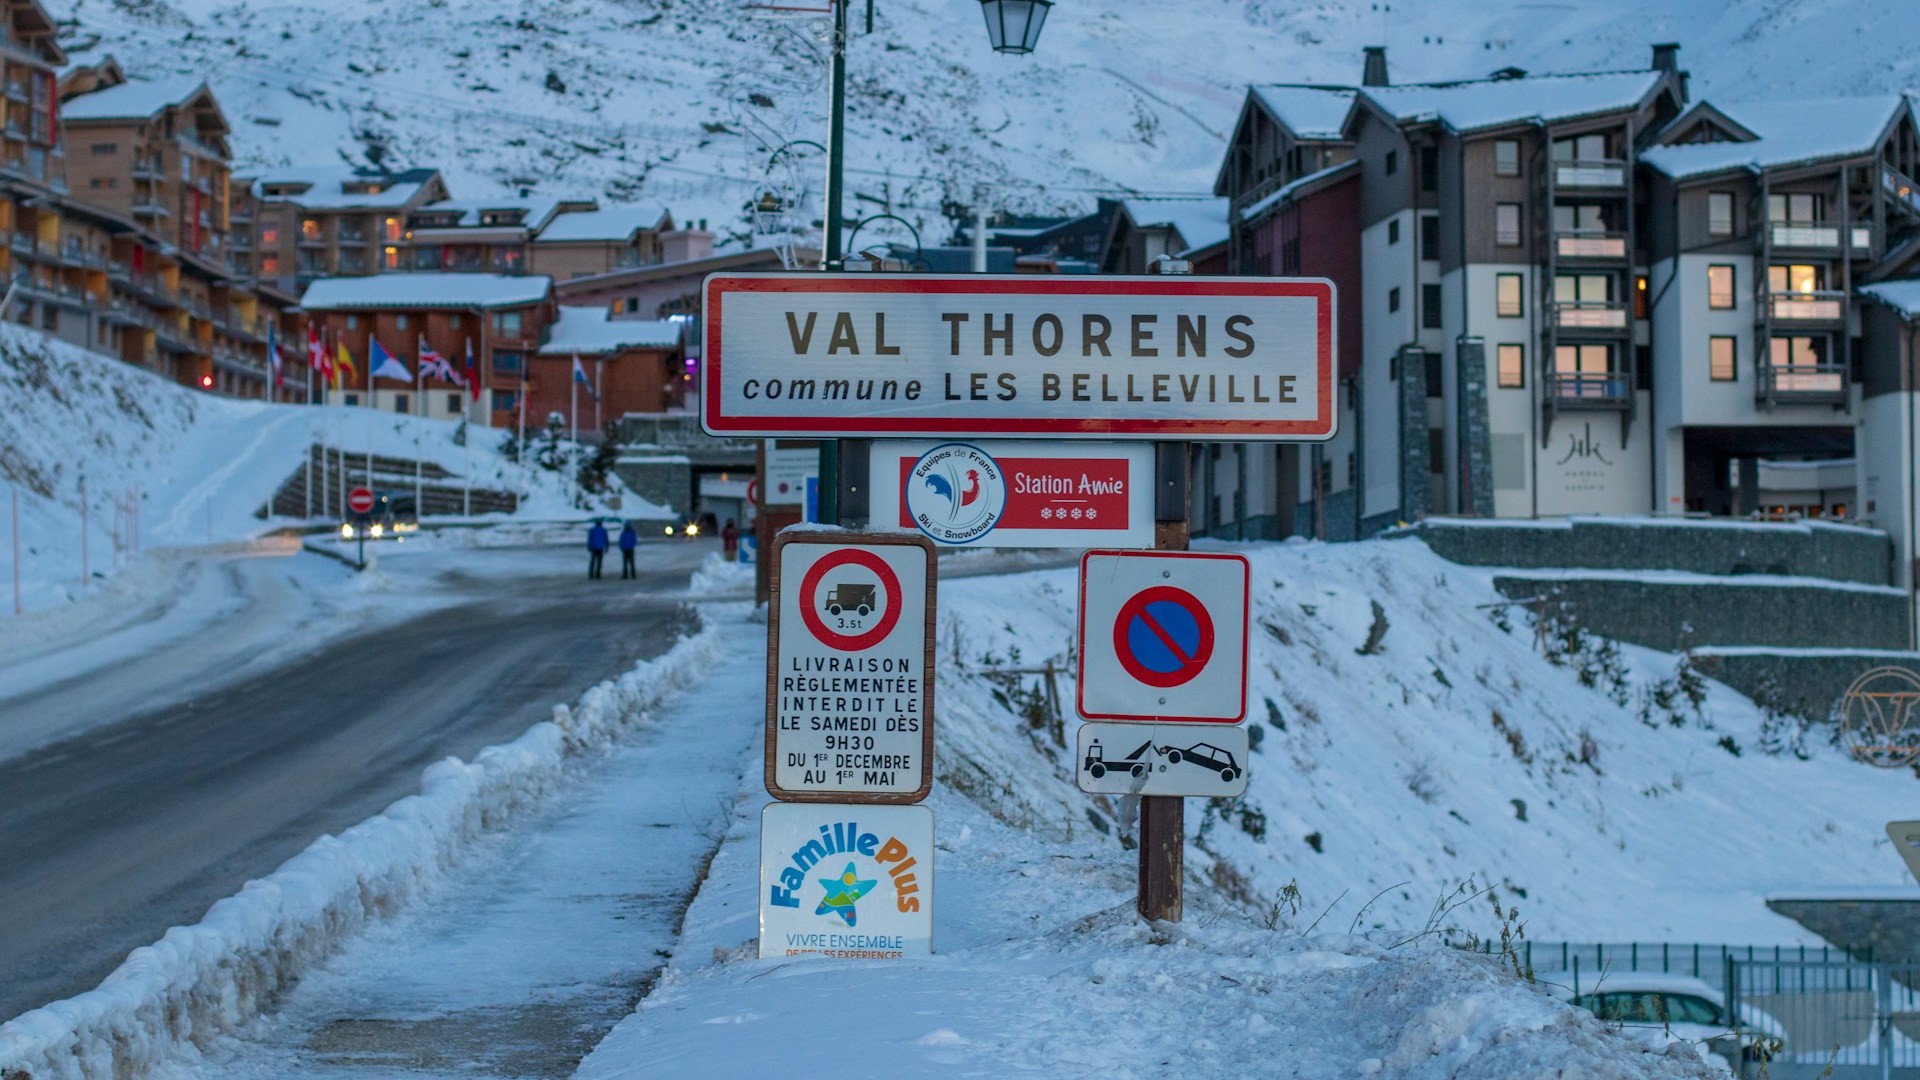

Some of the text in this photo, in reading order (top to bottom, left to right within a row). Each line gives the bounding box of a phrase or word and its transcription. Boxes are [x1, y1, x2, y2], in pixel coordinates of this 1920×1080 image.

[785, 311, 1256, 359] VAL THORENS
[743, 372, 1298, 403] commune LES BELLEVILLE
[916, 449, 996, 480] Equipes de France
[1015, 472, 1123, 496] Station Amie
[918, 512, 996, 539] Ski et Snowboard
[793, 657, 909, 673] LIVRAISON
[784, 674, 917, 693] RÈGLEMENTÉE
[784, 697, 917, 713] INTERDIT LE
[781, 714, 919, 732] LE SAMEDI DÈS
[825, 736, 874, 750] 9H30
[788, 753, 806, 767] DU
[836, 754, 910, 769] DECEMBRE
[803, 770, 826, 784] AU
[864, 771, 895, 786] MAI
[786, 934, 903, 948] VIVRE ENSEMBLE
